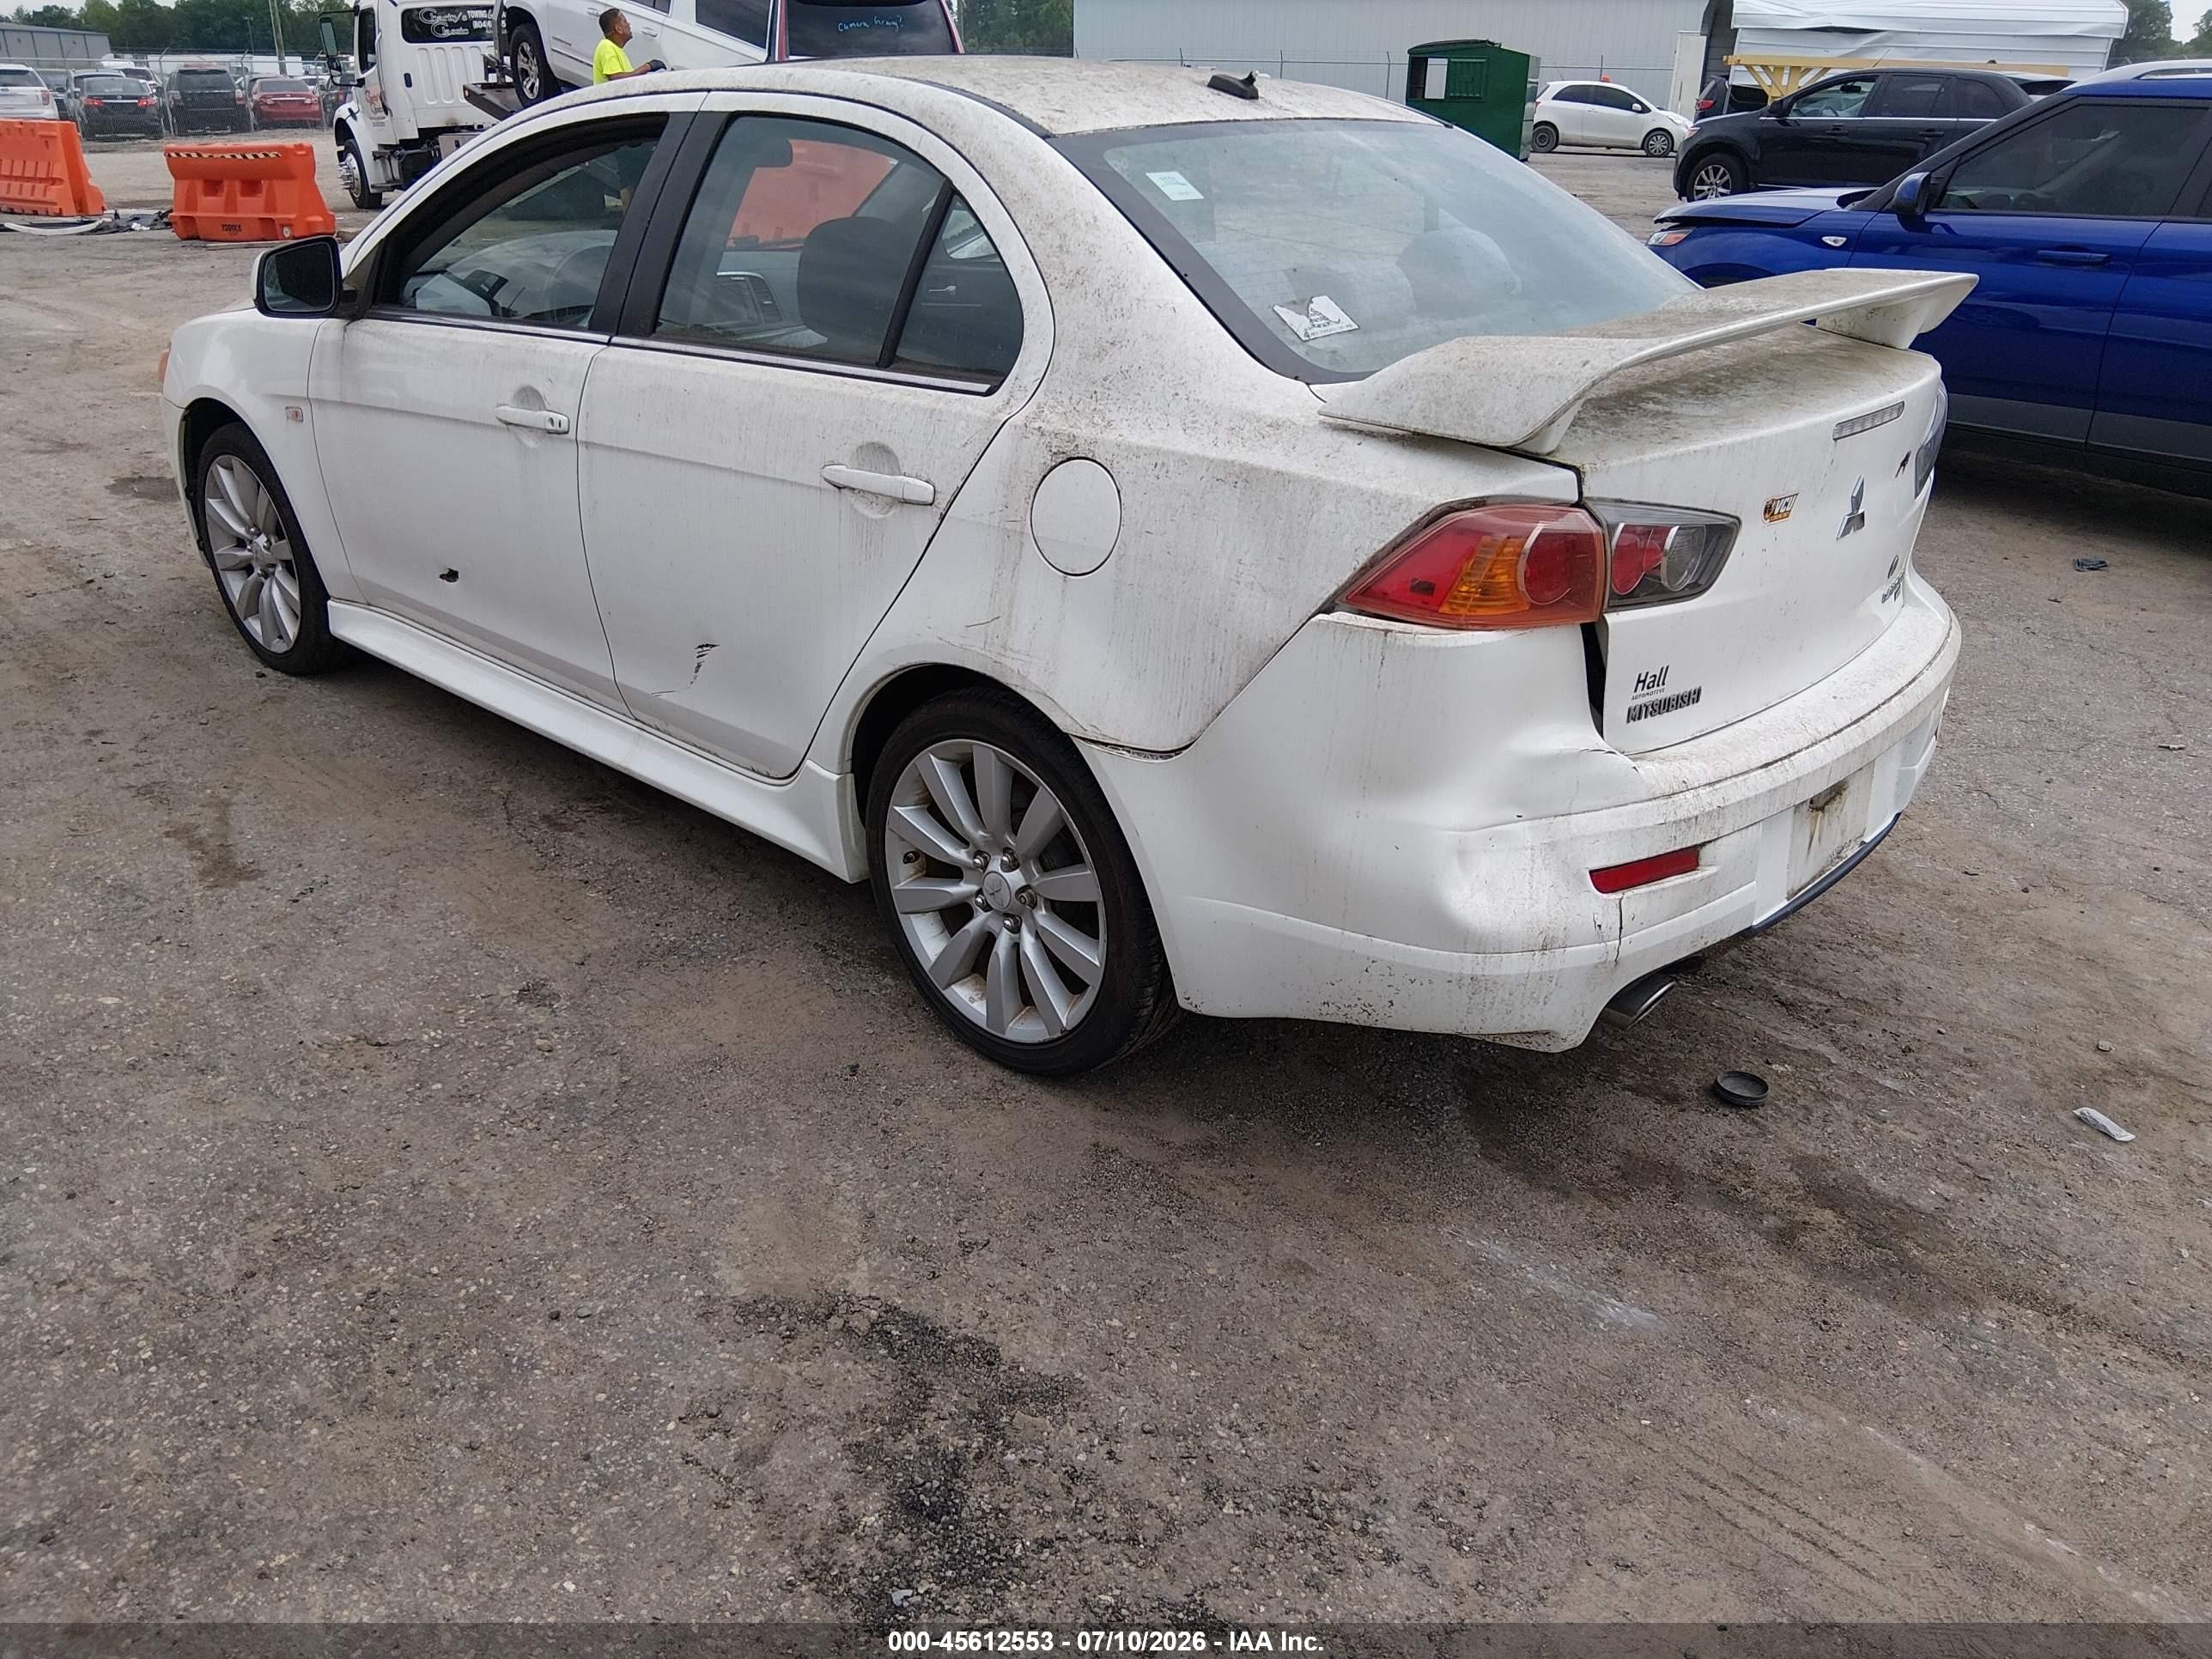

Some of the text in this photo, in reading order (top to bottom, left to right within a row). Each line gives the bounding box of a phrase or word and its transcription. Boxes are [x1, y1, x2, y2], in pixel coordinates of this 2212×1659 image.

[467, 9, 487, 19] TOWING
[1773, 495, 1798, 514] VCU
[1634, 665, 1669, 693] Hall
[1632, 688, 1665, 701] AUTOMOTIVE
[1626, 685, 1702, 724] MITSUBISHI
